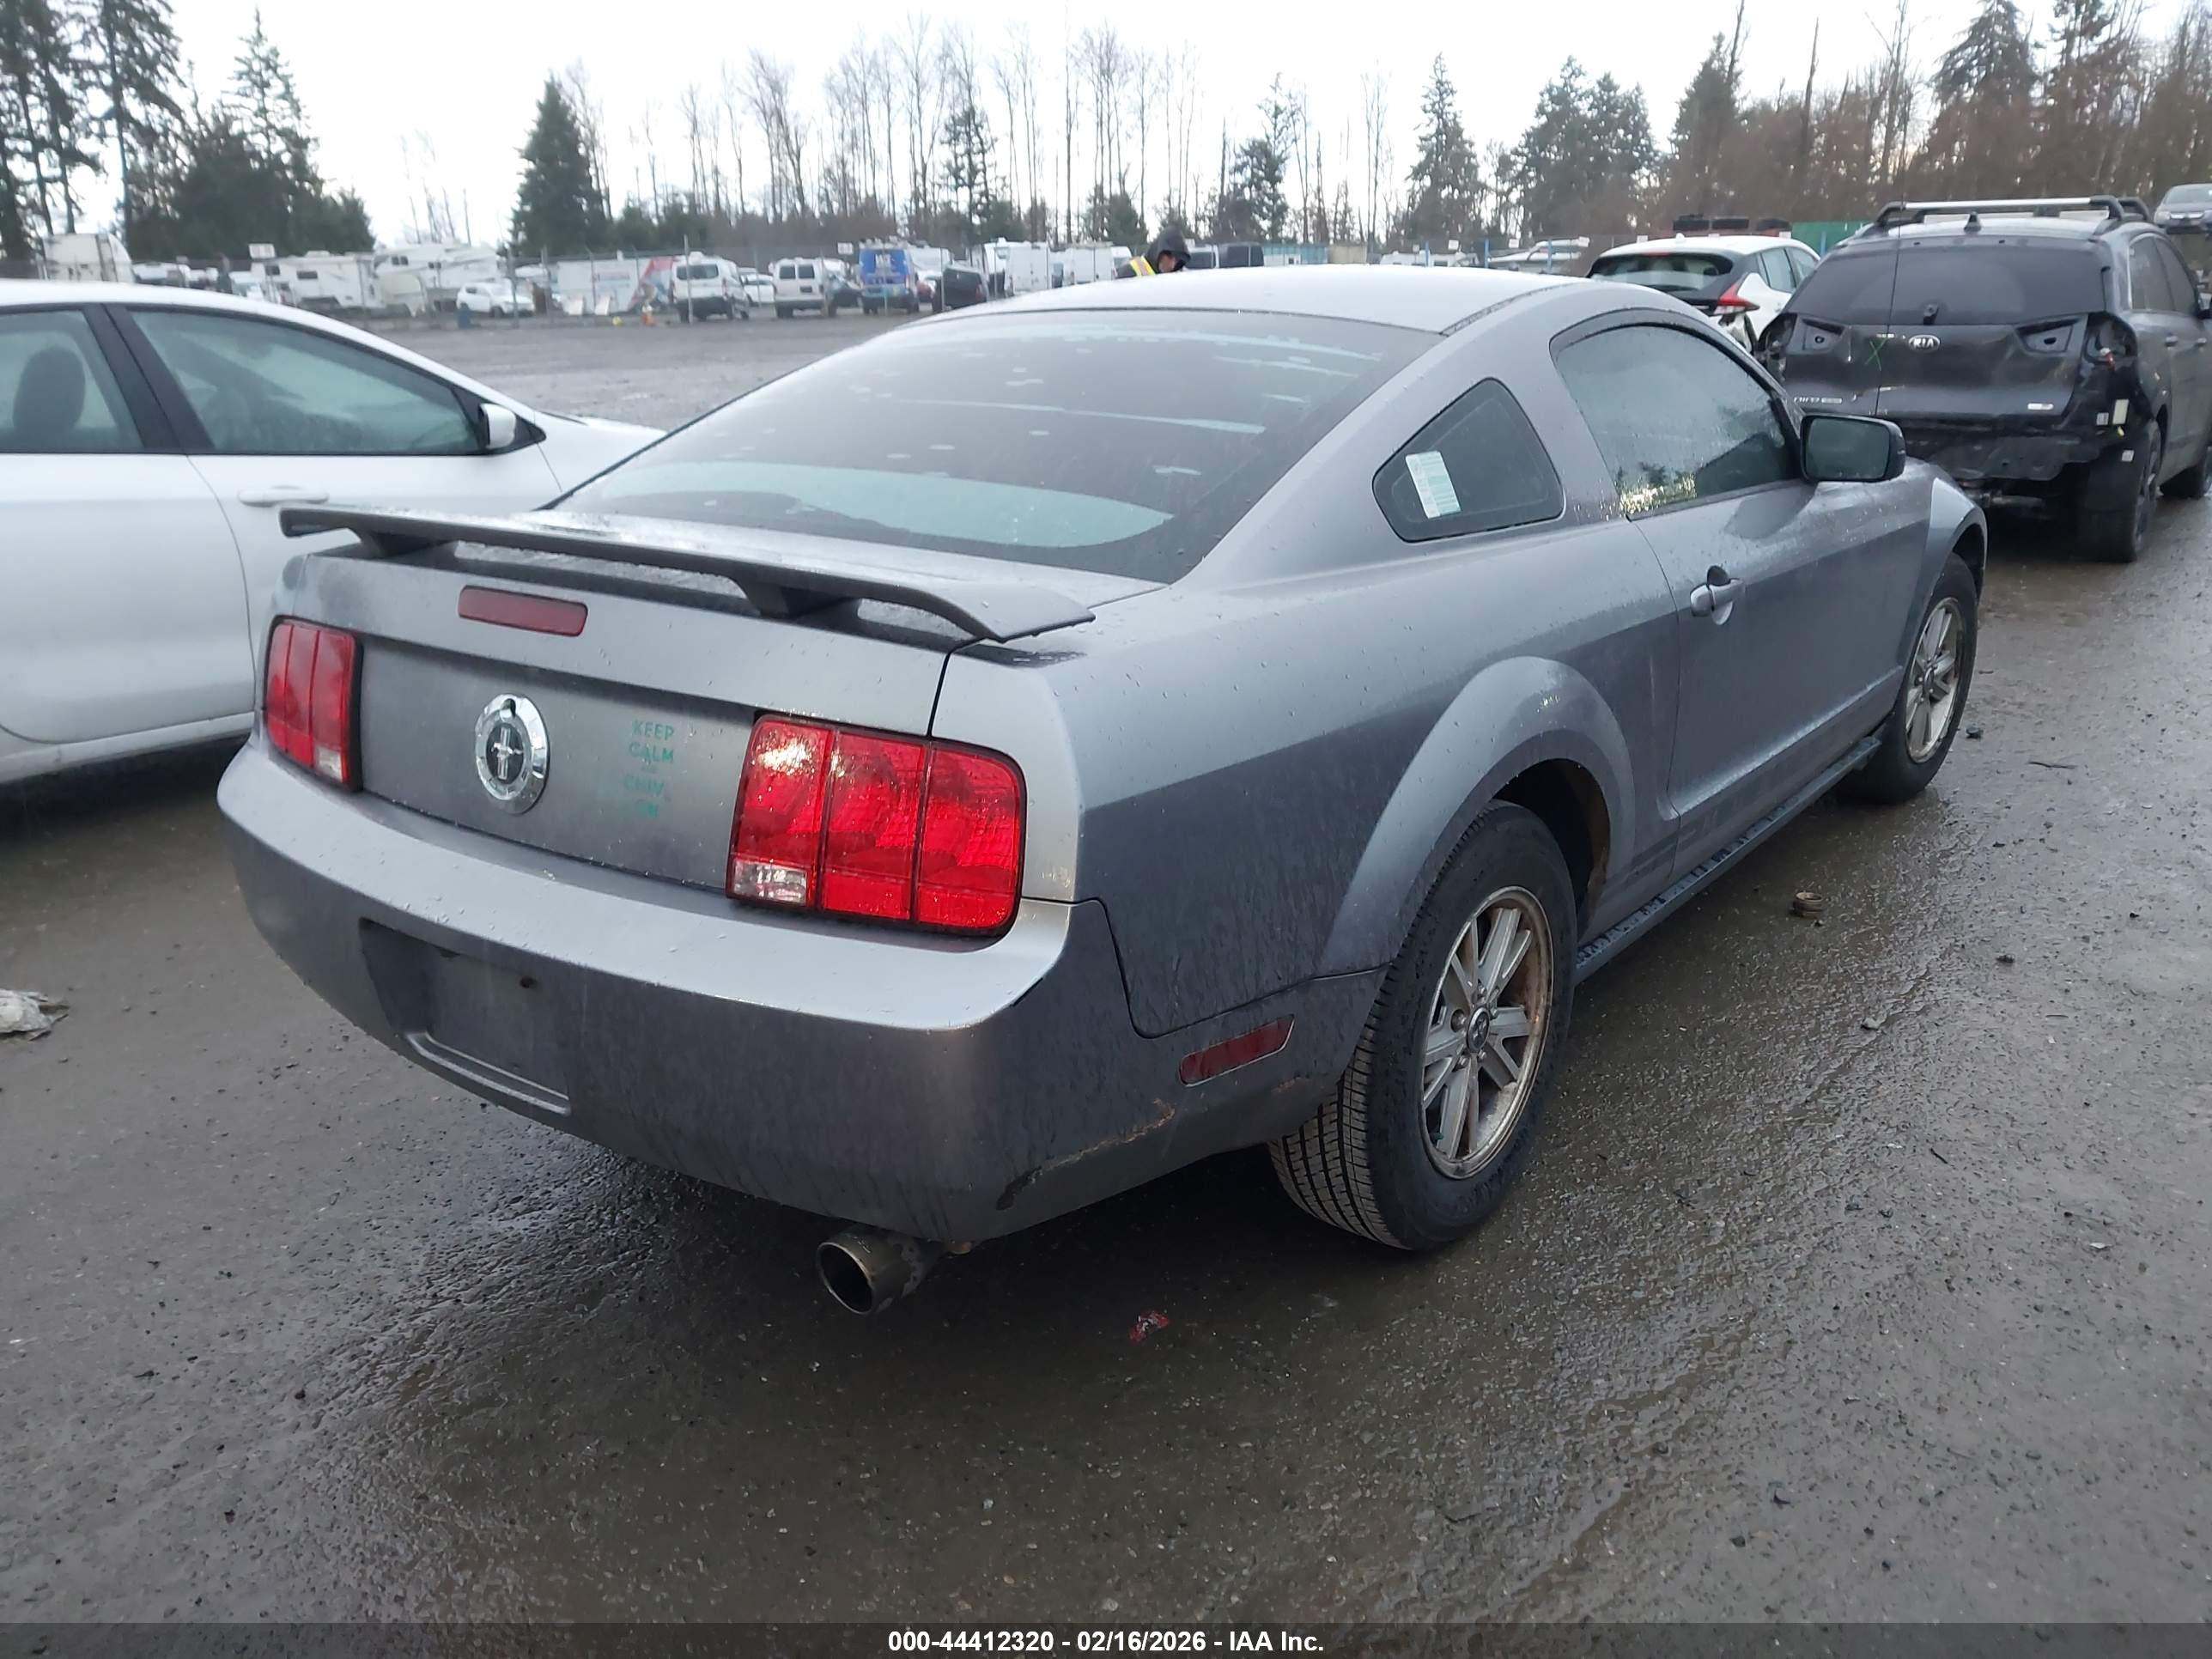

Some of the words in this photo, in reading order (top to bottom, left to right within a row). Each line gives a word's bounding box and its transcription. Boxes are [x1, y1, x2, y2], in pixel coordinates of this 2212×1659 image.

[1913, 337, 1934, 349] KIA
[632, 719, 674, 740] KEEP
[629, 741, 674, 763] CALM
